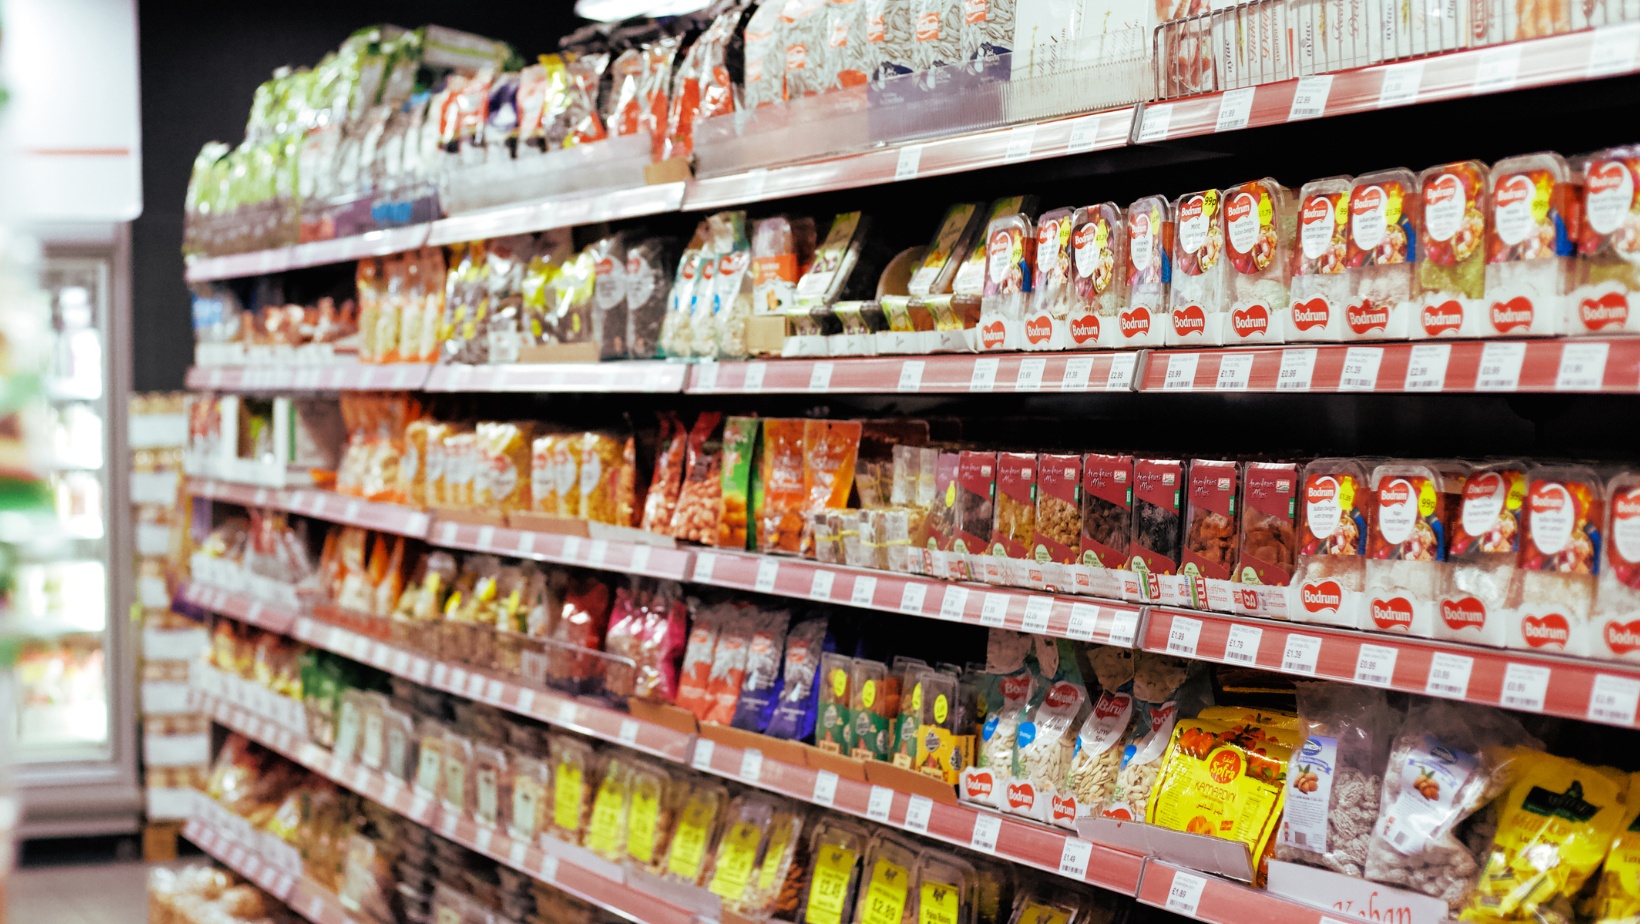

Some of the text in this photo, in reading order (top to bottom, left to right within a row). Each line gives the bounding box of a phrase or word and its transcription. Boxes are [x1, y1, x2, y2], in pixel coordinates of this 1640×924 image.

[1204, 196, 1217, 207] 99p
[1354, 199, 1380, 210] Bodrum
[1181, 206, 1202, 217] Bodrum
[1228, 205, 1250, 217] Bodrum
[1304, 208, 1326, 219] Bodrum
[1295, 309, 1327, 322] Bodrum
[1424, 310, 1461, 325] Bodrum
[1494, 309, 1531, 322] Bodrum
[1583, 305, 1626, 319] Bodrum
[1122, 315, 1148, 330] Bodrum
[1174, 315, 1203, 329] Bodrum
[1235, 316, 1266, 329] Bodrum
[1349, 312, 1386, 325] Bodrum
[983, 329, 1004, 342] Bodrum
[1027, 324, 1051, 337] Bodrum
[1071, 323, 1099, 337] Bodrum
[1111, 371, 1124, 379] £2.99
[1168, 370, 1182, 378] £0.99
[1220, 370, 1235, 378] £1.79
[1281, 369, 1297, 378] £0.99
[1345, 365, 1361, 375] £1.39
[1410, 367, 1427, 376] £2.99
[1308, 487, 1334, 498] Bodrum
[1381, 490, 1407, 502] Bodrum
[1421, 498, 1435, 509] 99p
[1304, 590, 1339, 605] Bodrum
[1373, 605, 1411, 622] Bodrum
[1444, 606, 1483, 623] Bodrum
[1171, 631, 1185, 641] £1.99
[1525, 624, 1567, 639] Bodrum
[1229, 639, 1244, 649] £1.79
[1286, 648, 1302, 659] £1.39
[1210, 760, 1236, 780] Sofra
[967, 777, 992, 791] Bodrum
[1009, 788, 1033, 804] Bodrum
[1063, 852, 1076, 863] £1.49
[1171, 887, 1187, 898] £1.89
